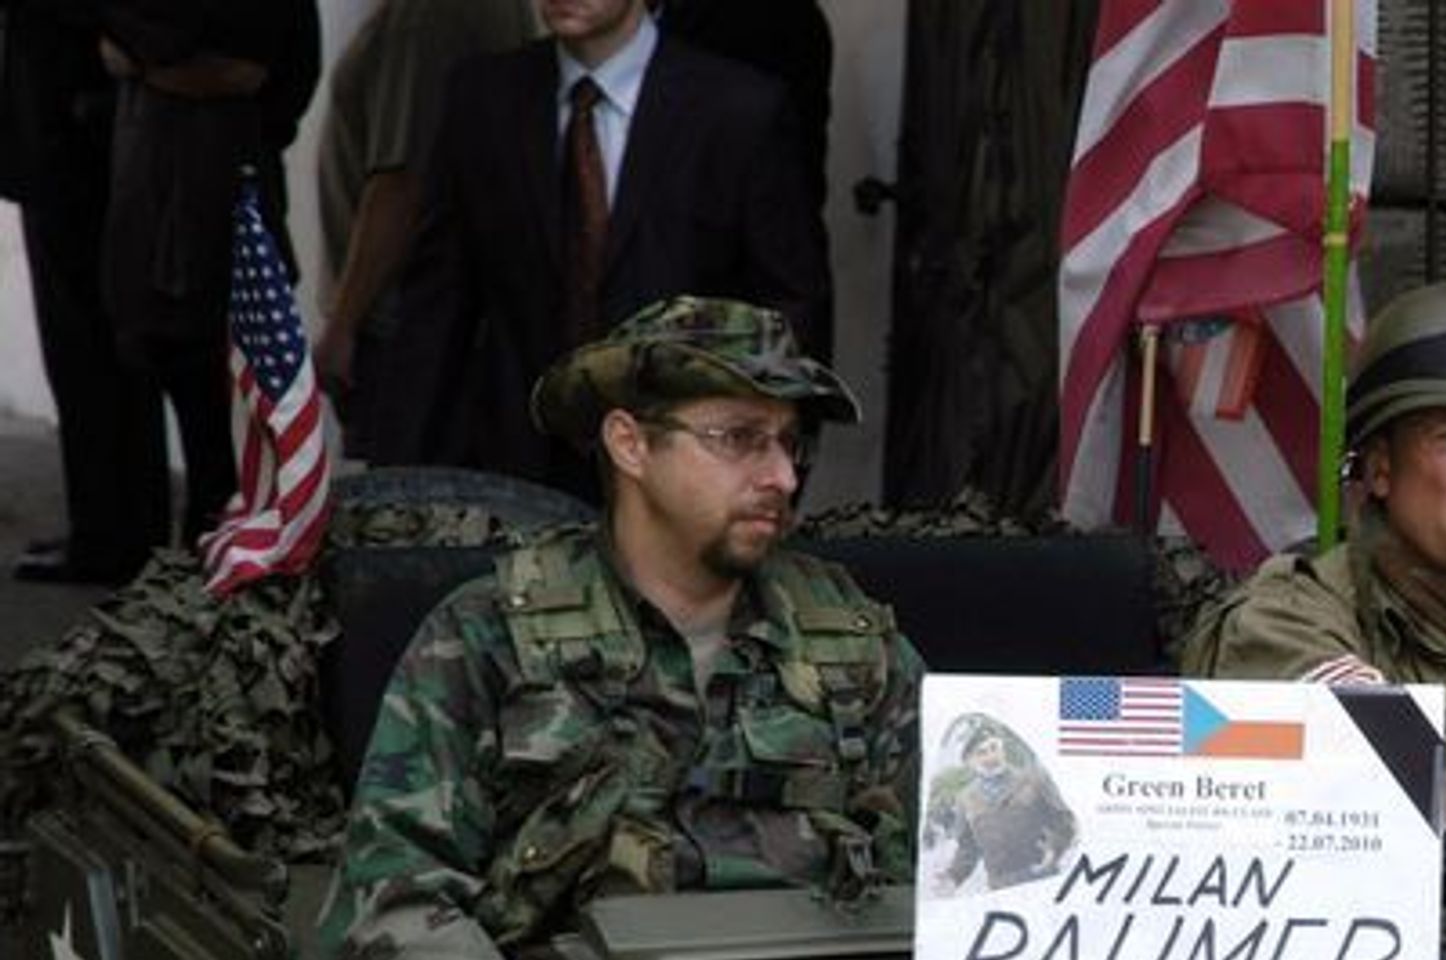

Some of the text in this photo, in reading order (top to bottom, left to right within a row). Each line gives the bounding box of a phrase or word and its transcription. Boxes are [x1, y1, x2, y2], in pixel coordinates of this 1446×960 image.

[1102, 774, 1266, 800] Green Beret
[1055, 852, 1295, 908] MILAN
